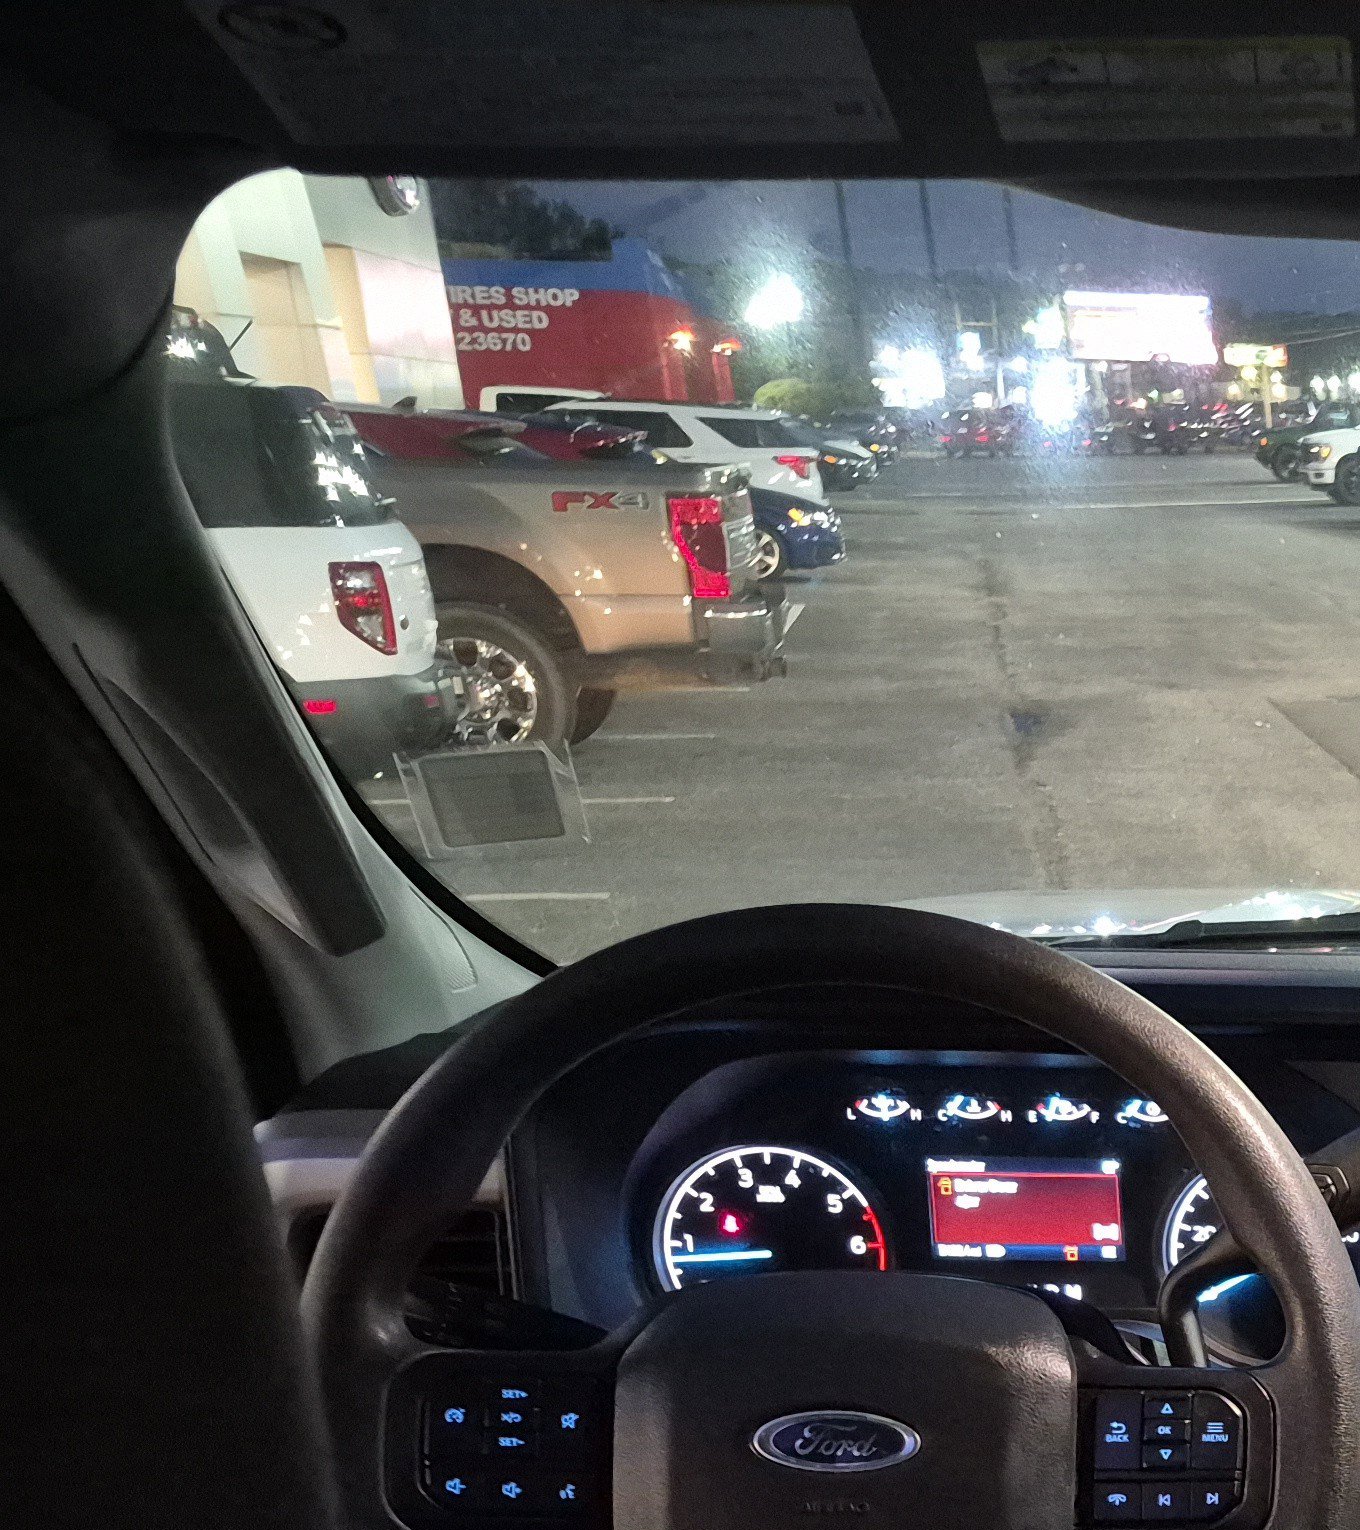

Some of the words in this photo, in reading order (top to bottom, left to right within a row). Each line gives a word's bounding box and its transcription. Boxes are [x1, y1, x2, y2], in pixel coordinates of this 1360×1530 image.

[447, 285, 506, 306] IRES
[511, 286, 580, 307] SHOP
[458, 308, 479, 328] &
[480, 309, 550, 330] USED
[456, 331, 532, 352] 23670
[551, 490, 650, 512] FX4
[846, 1108, 857, 1121] L
[910, 1108, 922, 1121] H
[938, 1109, 948, 1122] C
[1000, 1110, 1012, 1123] H
[1028, 1110, 1038, 1123] E
[1090, 1111, 1100, 1124] F
[1115, 1112, 1127, 1125] C
[737, 1168, 754, 1188] 3
[784, 1169, 801, 1189] 4
[699, 1192, 715, 1212] 2
[826, 1193, 844, 1214] 5
[683, 1232, 694, 1253] 1
[849, 1234, 868, 1255] 6
[794, 1422, 878, 1457] Ford
[1105, 1434, 1130, 1443] BACK
[1157, 1425, 1172, 1435] OK
[1201, 1433, 1229, 1443] MENU
